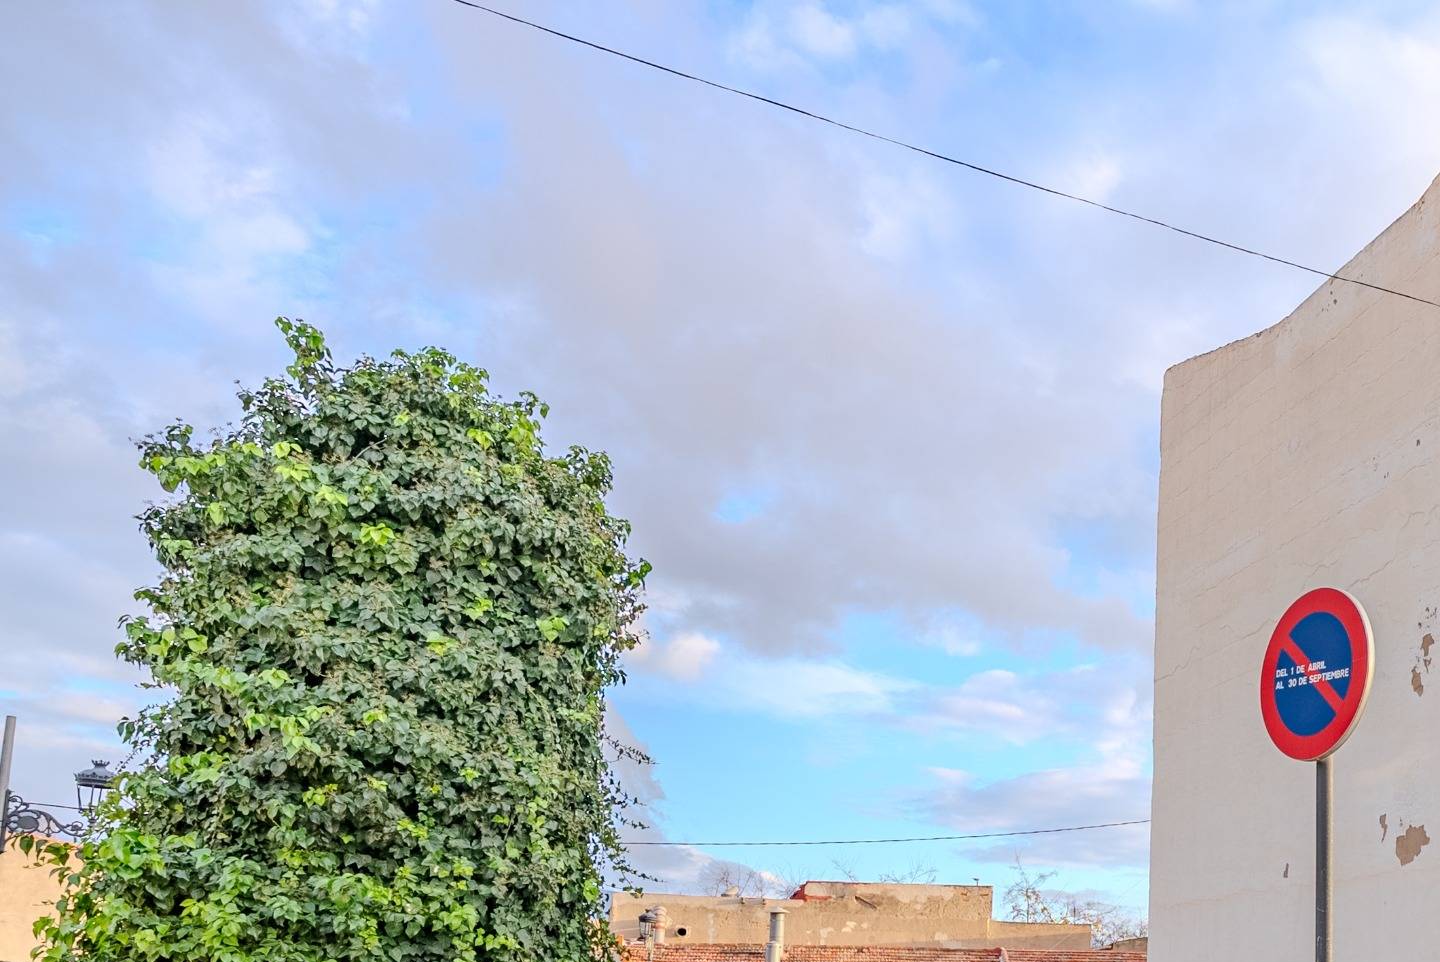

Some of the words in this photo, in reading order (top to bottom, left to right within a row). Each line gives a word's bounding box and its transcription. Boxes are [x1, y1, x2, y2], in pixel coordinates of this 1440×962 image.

[1275, 681, 1284, 690] AL
[1288, 679, 1297, 688] 30
[1298, 676, 1308, 686] DE
[1309, 668, 1350, 684] SEPTIEMBRE
[1276, 668, 1288, 678] DEL
[1291, 666, 1294, 675] 1
[1296, 665, 1305, 674] DE
[1308, 661, 1327, 672] ABRIL
